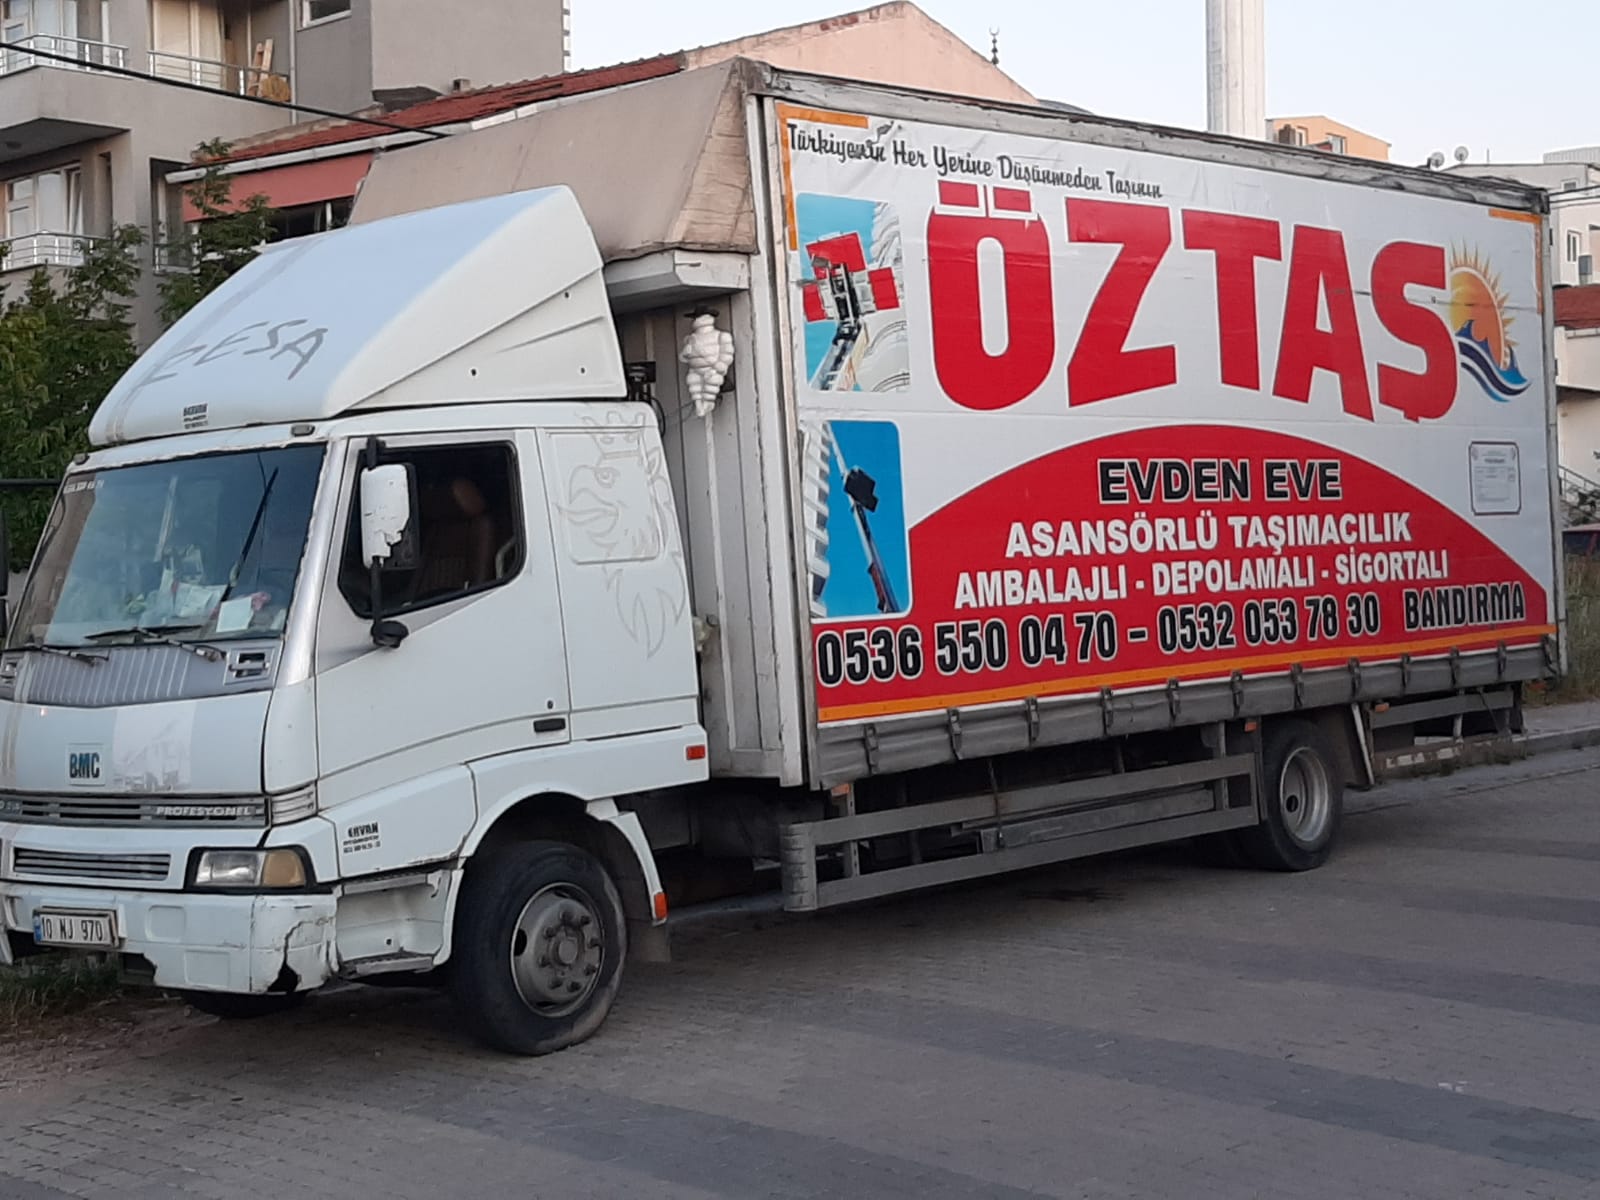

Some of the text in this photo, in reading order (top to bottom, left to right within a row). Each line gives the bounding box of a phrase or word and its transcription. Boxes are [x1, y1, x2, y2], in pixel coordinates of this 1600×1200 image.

[892, 140, 927, 168] Her
[933, 146, 993, 176] Yerine
[997, 155, 1102, 192] Düşünmeden
[926, 180, 1458, 423] ÖZTAŞ
[1098, 458, 1342, 504] EVDEN EVE
[1005, 509, 1412, 559] ASANSÖRLÜ TAŞIMACILIK
[954, 569, 1127, 610] AMBALAJLI
[1153, 555, 1315, 597] DEPOLAMALI
[1335, 546, 1448, 585] SİGORTALI
[816, 624, 922, 687] 0536
[934, 617, 1008, 674] 550
[1019, 613, 1066, 667] 04
[1074, 610, 1117, 664] 70
[1157, 604, 1235, 653] 0532
[1244, 599, 1298, 646] 053
[1306, 596, 1339, 641] 78
[1347, 592, 1380, 636] 30
[1403, 580, 1526, 632] BANDIRMA
[69, 752, 100, 779] BMC
[41, 916, 103, 942] 10 NJ 970
